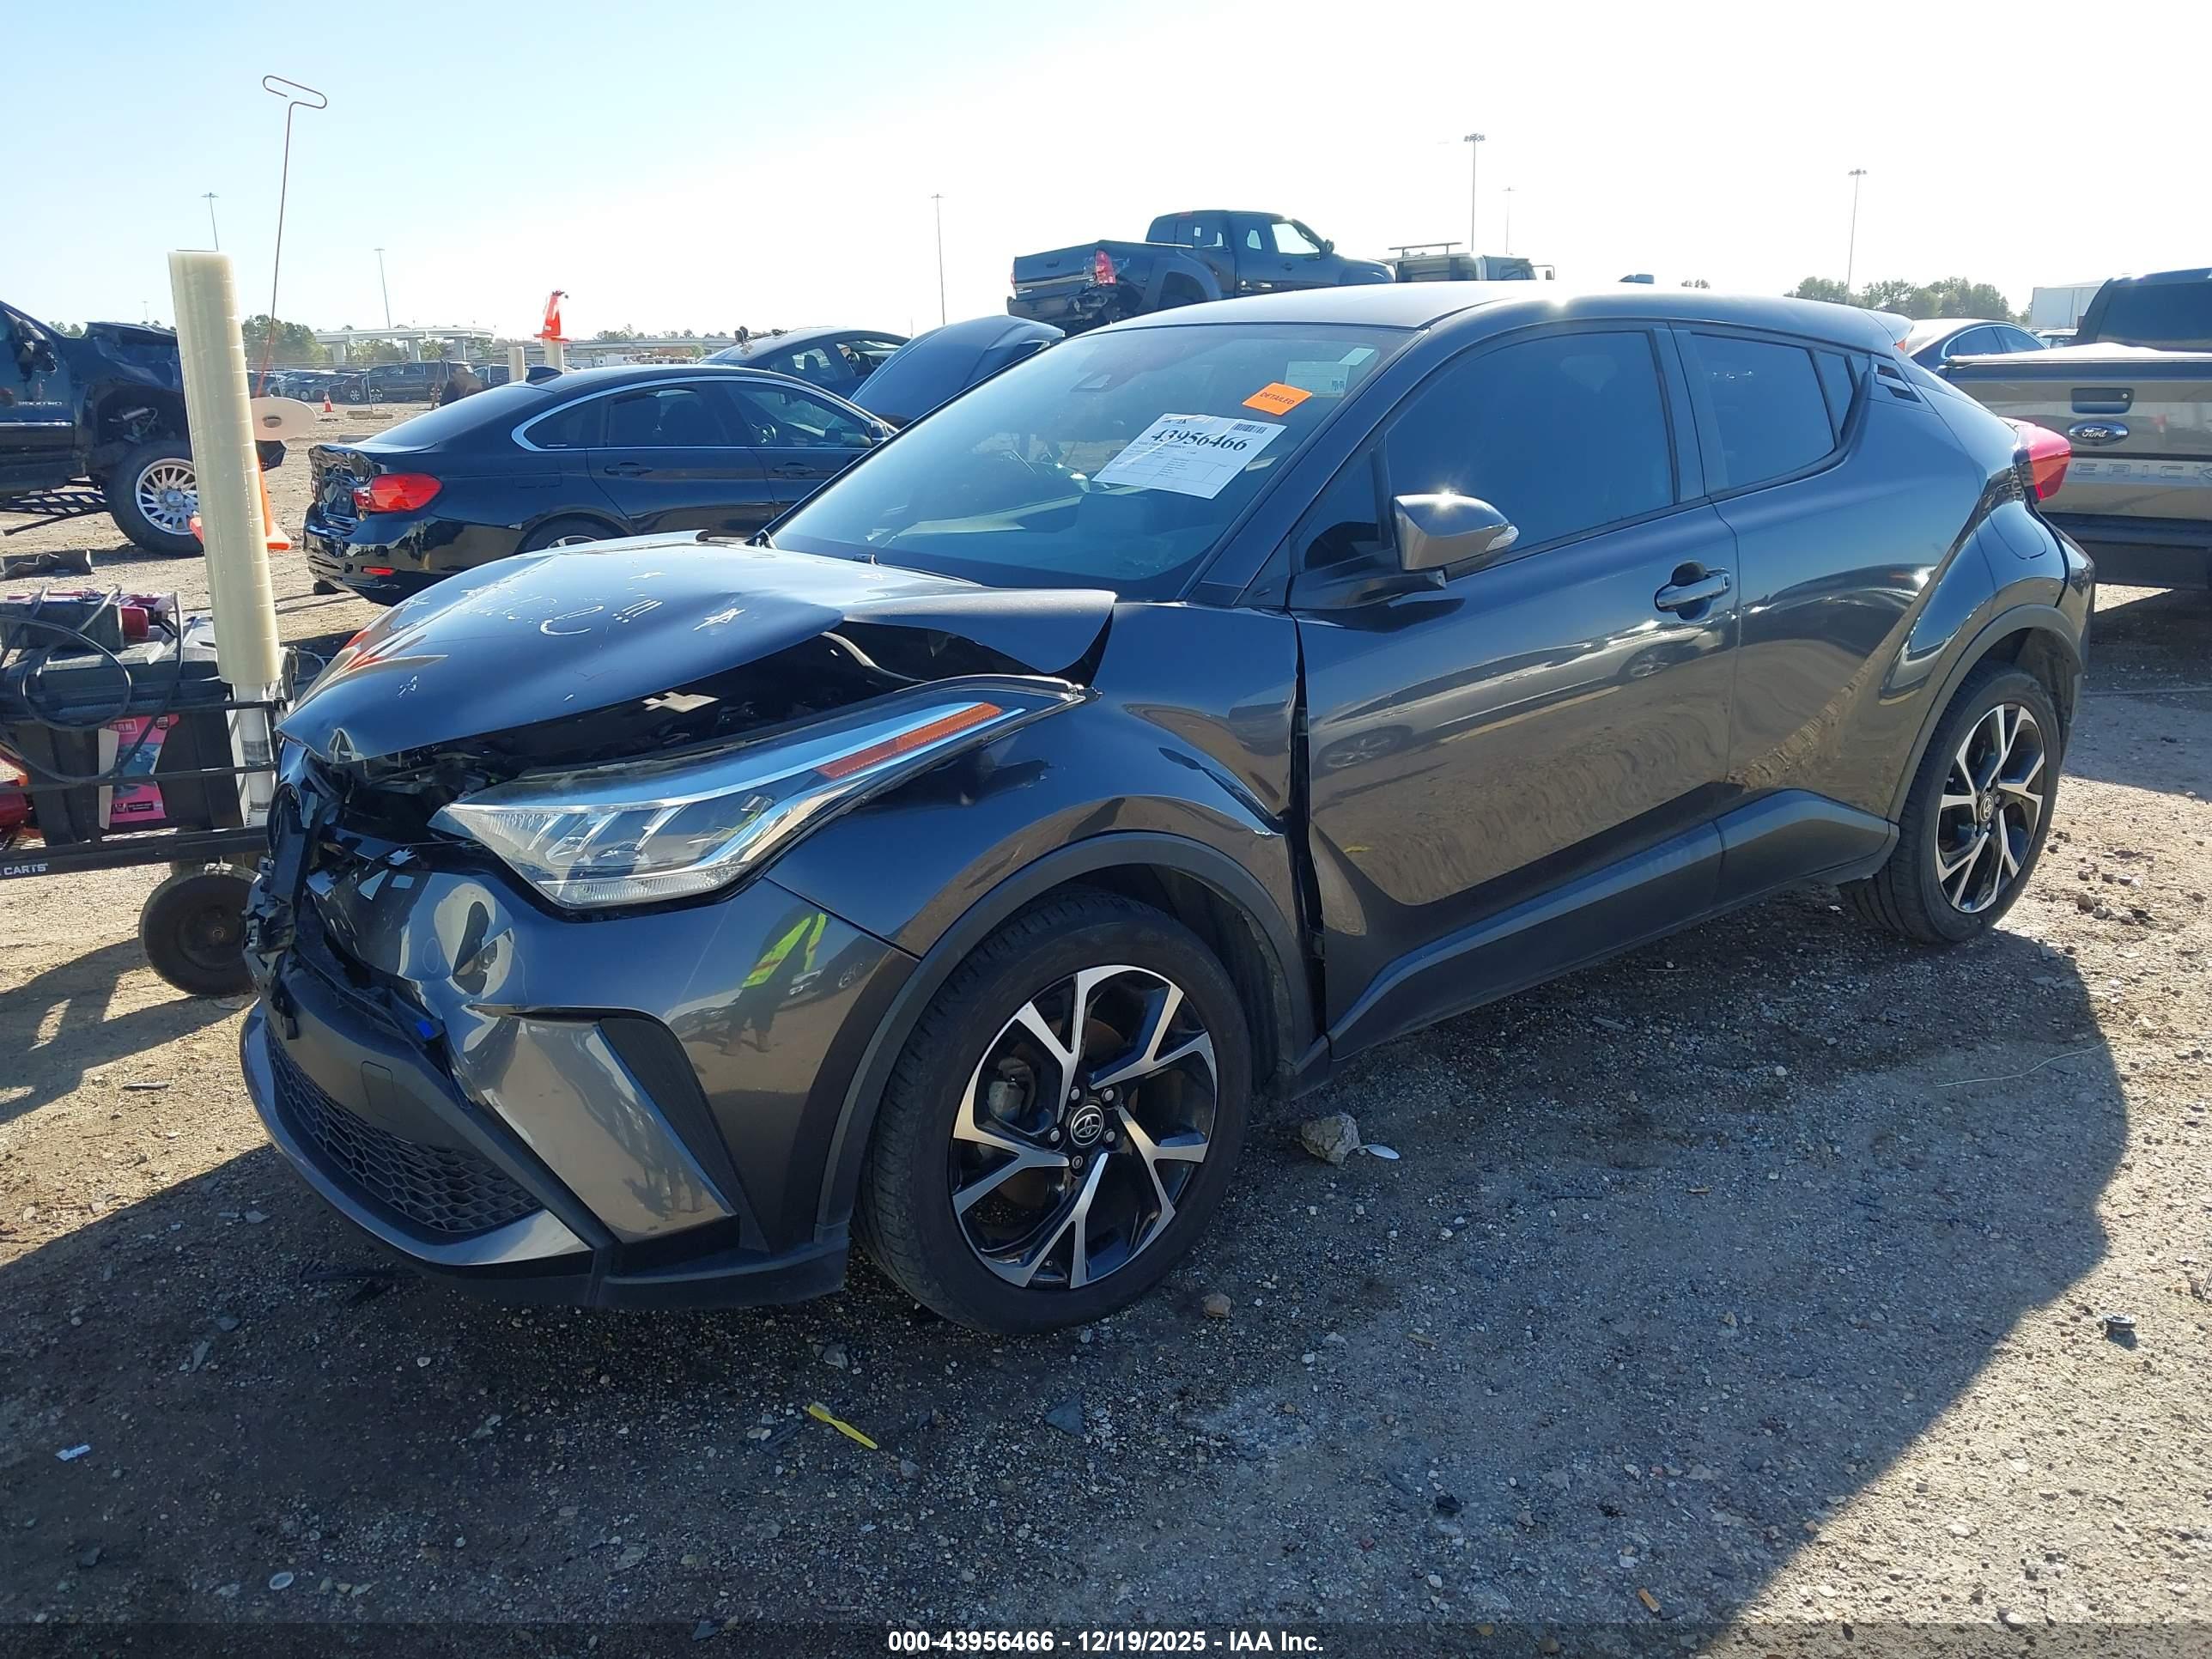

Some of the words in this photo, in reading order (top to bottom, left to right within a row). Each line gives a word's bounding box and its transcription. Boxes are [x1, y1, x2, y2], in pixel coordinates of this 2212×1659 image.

[1152, 428, 1253, 452] 43956466
[2081, 428, 2108, 438] Ford
[2074, 463, 2212, 481] ERICK
[3, 864, 46, 876] CARTS
